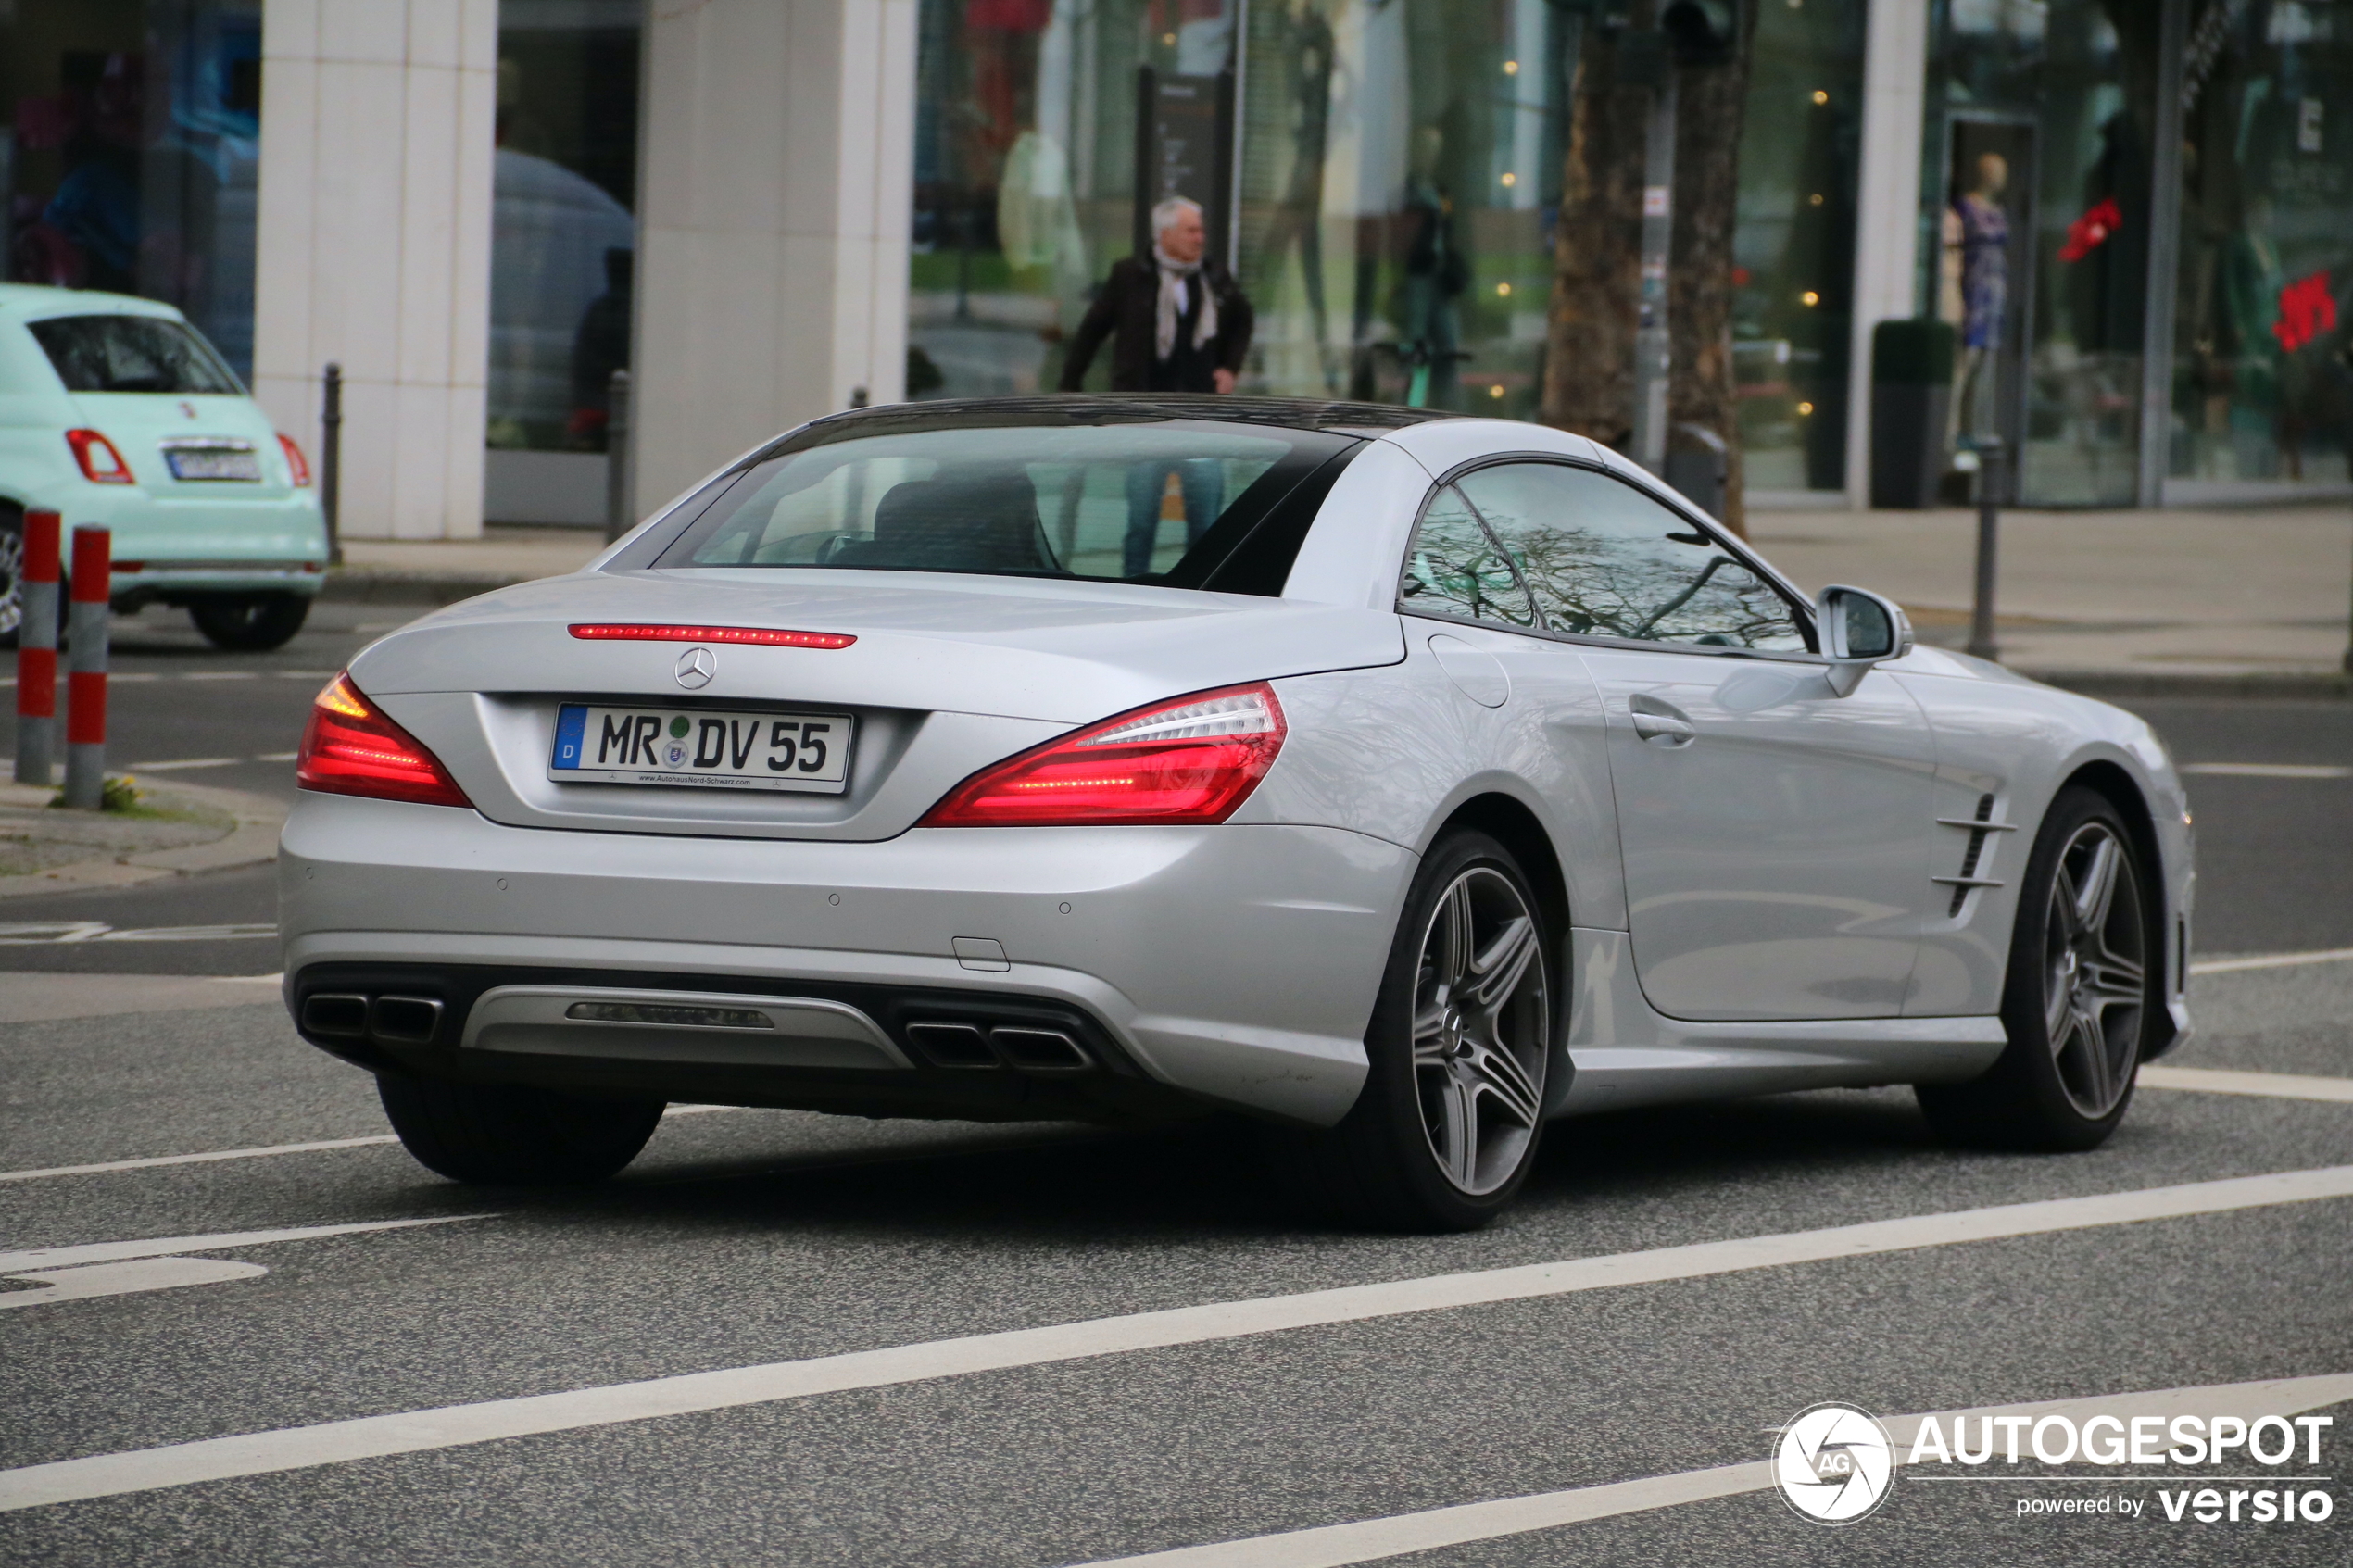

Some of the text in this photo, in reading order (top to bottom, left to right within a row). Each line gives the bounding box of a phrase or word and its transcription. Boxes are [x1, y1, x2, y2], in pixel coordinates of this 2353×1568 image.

[562, 714, 830, 771] D MR DV 55
[638, 774, 750, 786] www.AutohausNord-Schwarz.com
